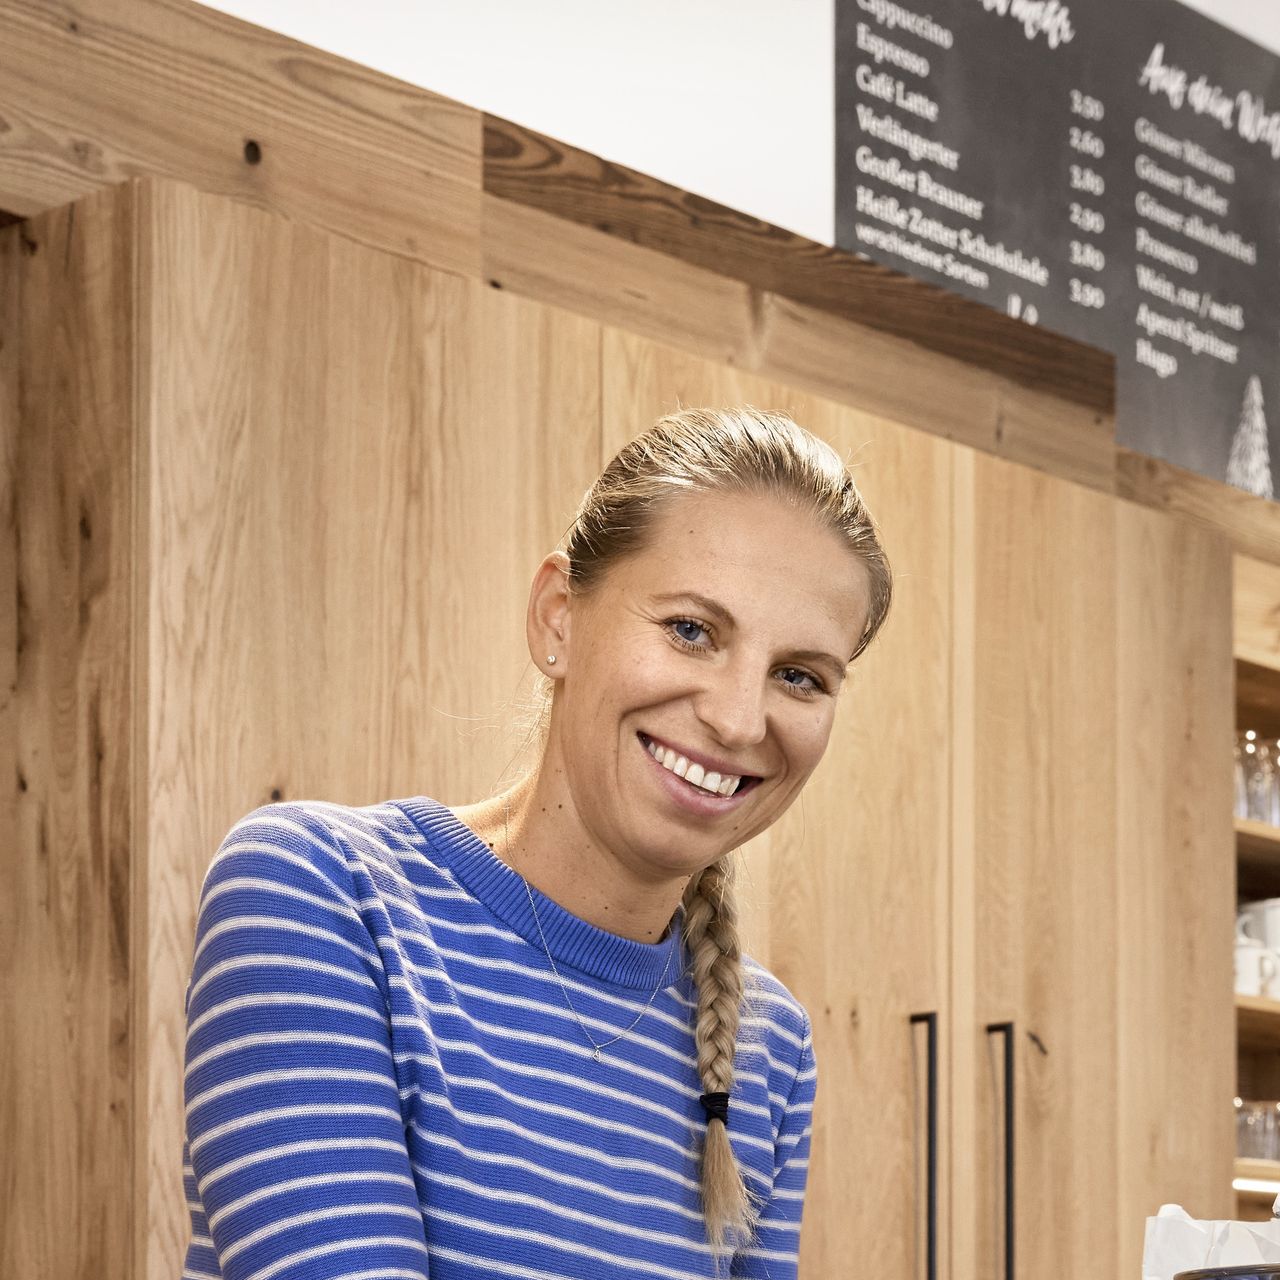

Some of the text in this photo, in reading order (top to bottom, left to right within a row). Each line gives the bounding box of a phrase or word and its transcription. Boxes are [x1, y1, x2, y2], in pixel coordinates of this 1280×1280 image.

[857, 23, 929, 77] Espresso
[856, 64, 939, 122] Café Latte
[856, 104, 960, 170] Verlängerter
[856, 146, 984, 220] Großer Brauner
[855, 223, 989, 290] verschiedene Sorten
[856, 185, 1049, 286] Heiße Zotter Schokolade
[1136, 228, 1198, 274] Prosecco
[1136, 304, 1184, 342] Aperol
[1136, 339, 1177, 378] Hugo
